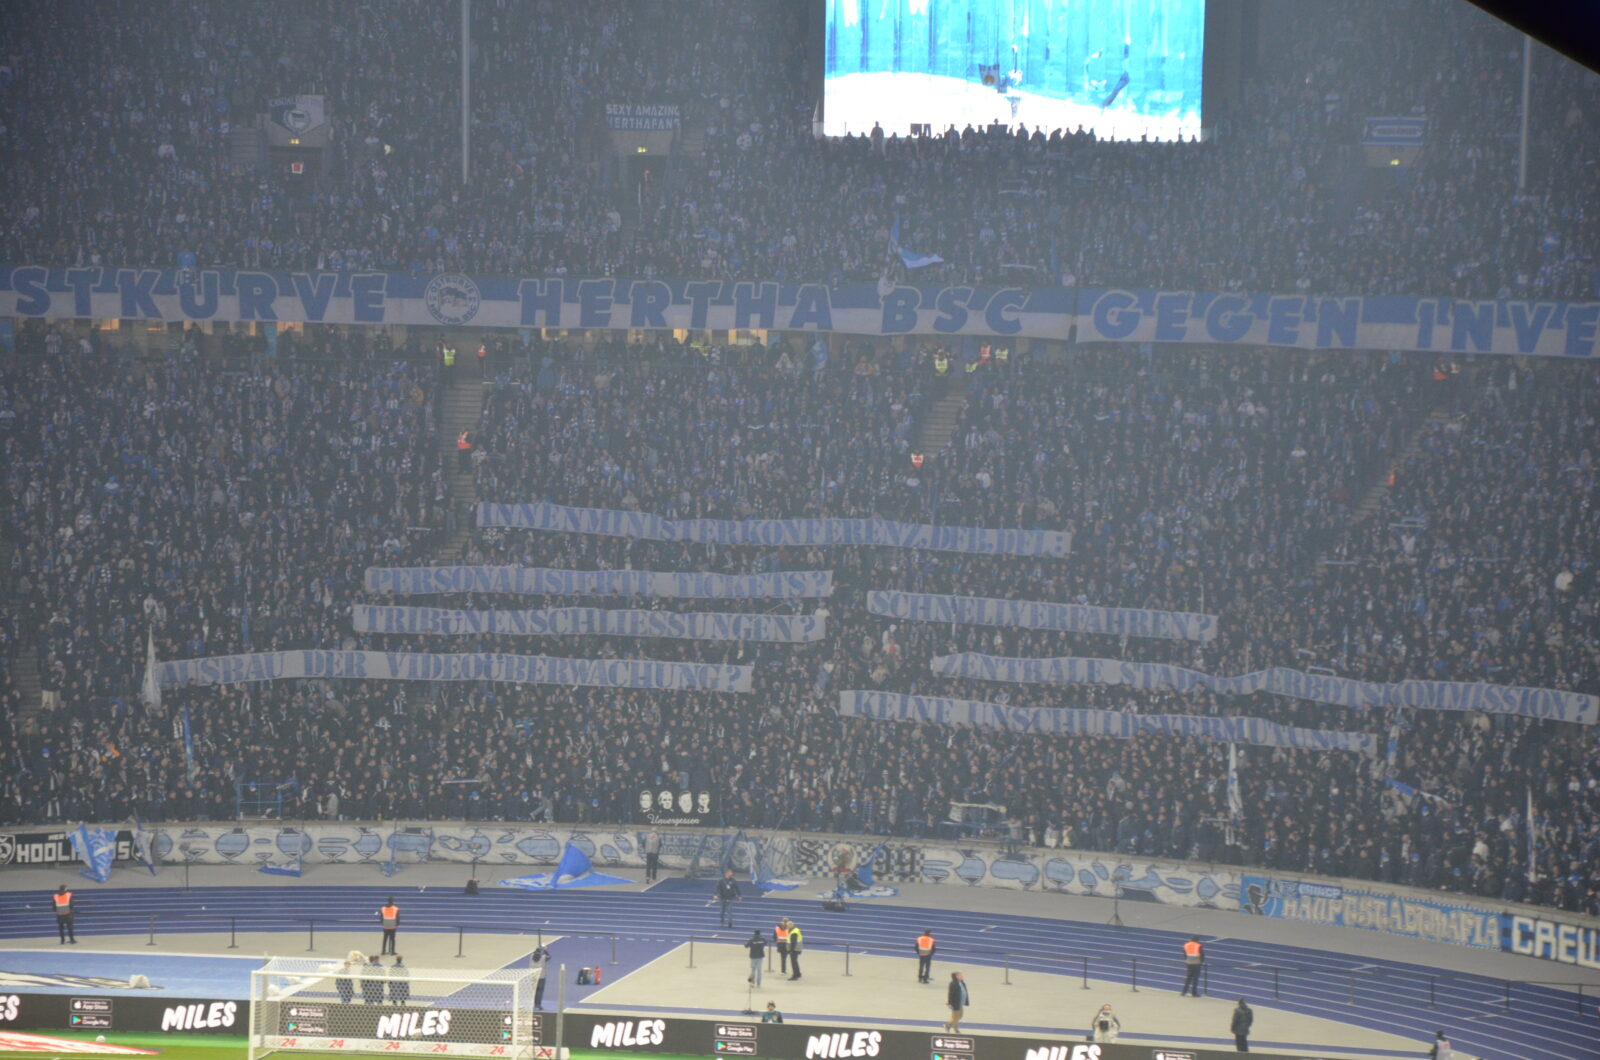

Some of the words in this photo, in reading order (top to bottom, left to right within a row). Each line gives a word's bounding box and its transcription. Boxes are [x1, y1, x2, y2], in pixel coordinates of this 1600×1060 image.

[605, 104, 632, 115] SEXY
[635, 104, 680, 116] AMAZING
[517, 277, 833, 331] HERTHA
[879, 284, 1033, 335] BSC
[1091, 288, 1364, 350] GEGEN
[1414, 298, 1600, 358] INVE
[672, 571, 829, 598] TICKETS?
[303, 650, 367, 678] DER
[941, 652, 1104, 683] ZENTRALE
[852, 689, 955, 725] KEINE
[646, 813, 700, 826] Unvergessen
[16, 841, 131, 863] HOOLIS
[161, 1001, 238, 1032] MILES
[376, 1010, 451, 1039] MILES
[590, 1019, 666, 1048] MILES
[805, 1030, 882, 1060] MILES
